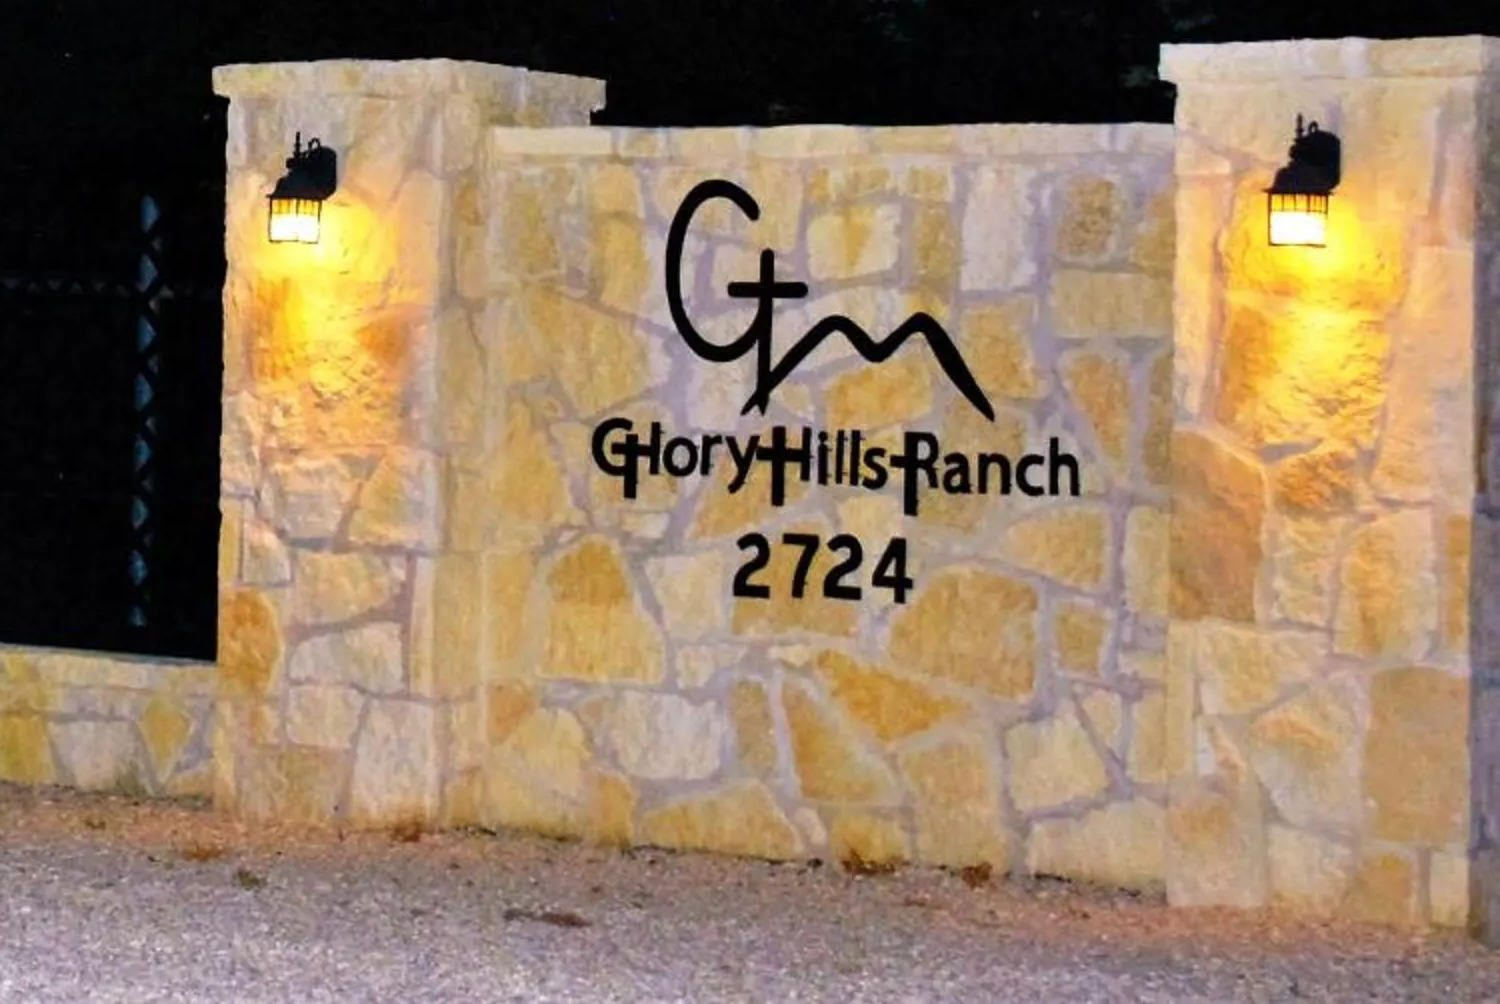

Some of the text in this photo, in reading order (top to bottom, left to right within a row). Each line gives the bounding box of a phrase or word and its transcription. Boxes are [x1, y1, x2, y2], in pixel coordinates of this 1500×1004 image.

[591, 417, 1081, 517] Glory Hills Ranch
[732, 532, 914, 605] 2724
